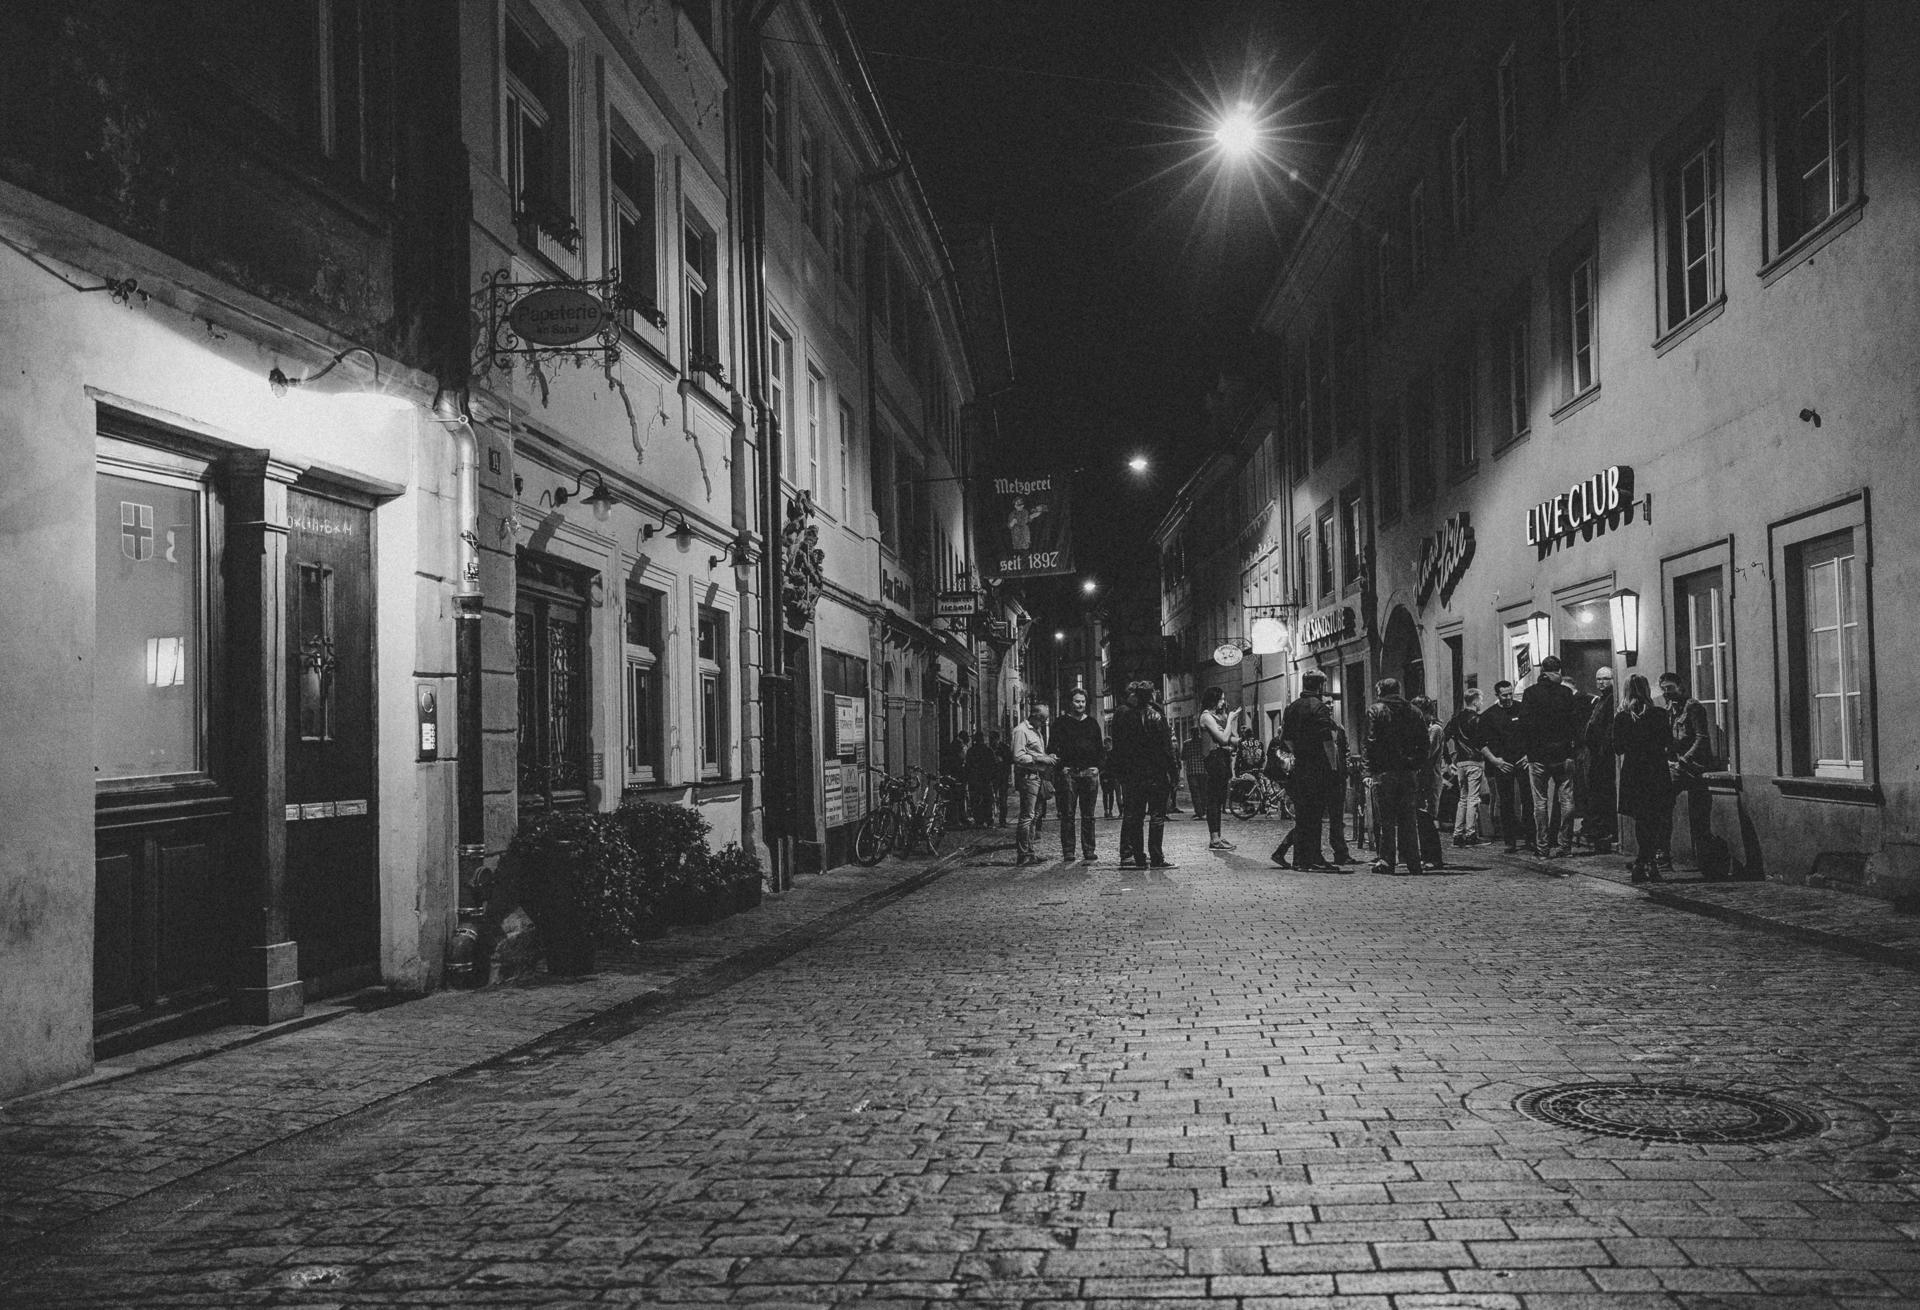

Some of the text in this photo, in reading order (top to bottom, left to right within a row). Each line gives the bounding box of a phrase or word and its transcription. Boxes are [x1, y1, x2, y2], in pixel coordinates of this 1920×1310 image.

[519, 303, 598, 325] Papeterie
[993, 474, 1051, 495] Metzgerei
[1526, 465, 1619, 546] LIVE CLUB
[999, 555, 1022, 572] seit
